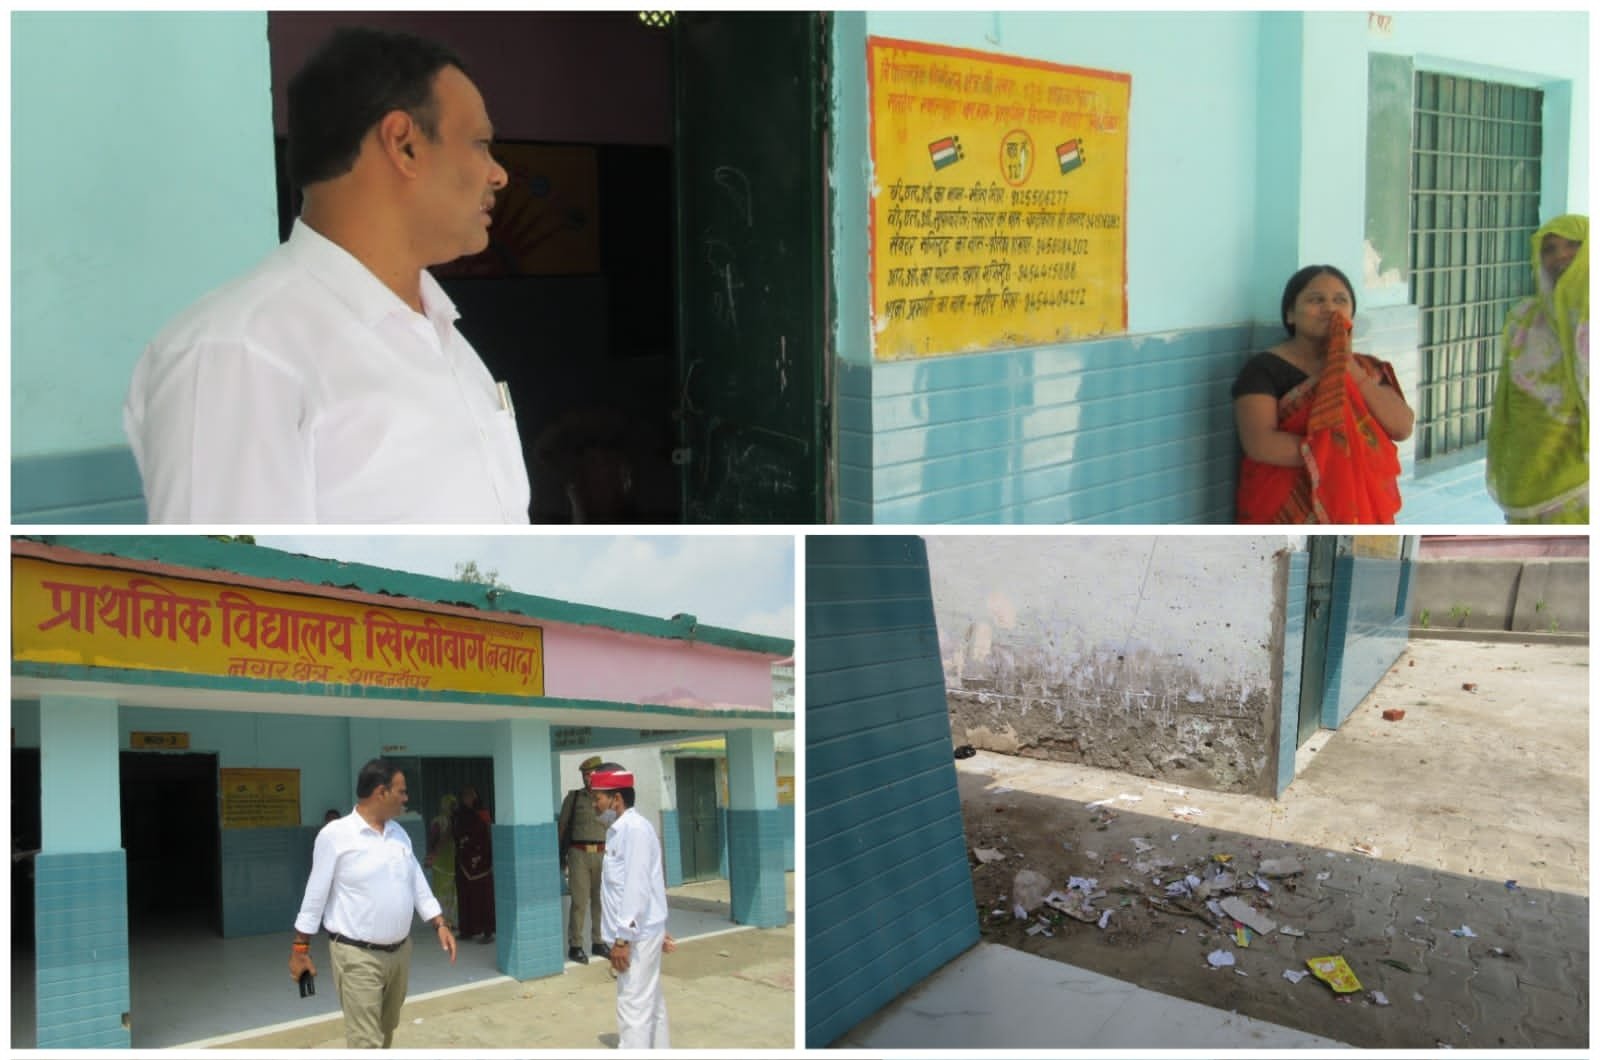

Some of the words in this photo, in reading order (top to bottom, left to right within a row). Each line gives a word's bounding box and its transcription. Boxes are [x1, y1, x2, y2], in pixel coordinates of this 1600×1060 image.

[38, 578, 212, 645] प्राथमिक
[216, 591, 355, 661] विद्यालय
[363, 610, 486, 670] खिरनीबाग
